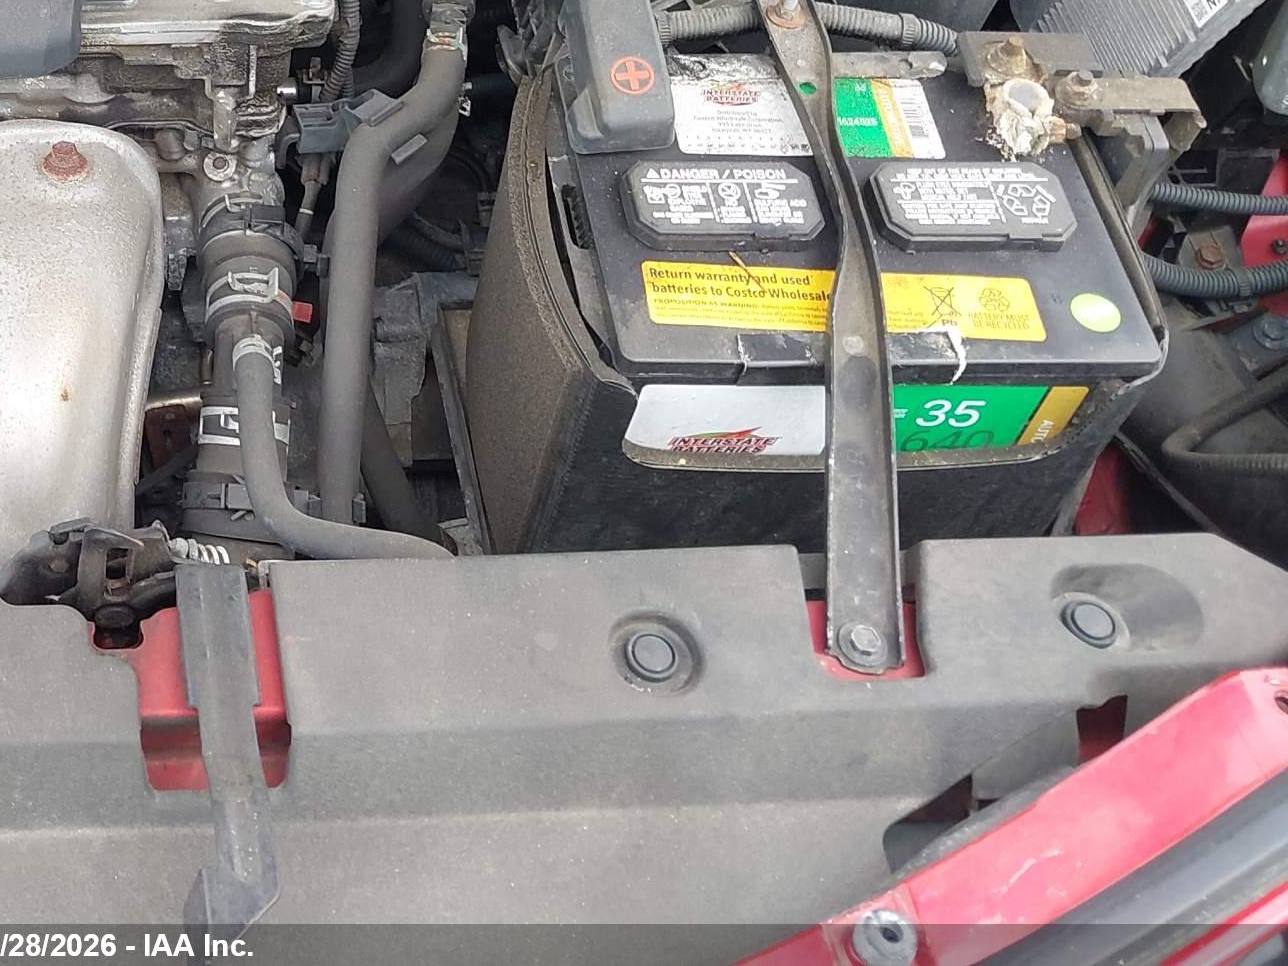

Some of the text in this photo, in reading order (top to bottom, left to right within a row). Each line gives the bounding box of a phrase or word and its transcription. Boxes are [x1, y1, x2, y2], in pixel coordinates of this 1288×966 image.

[660, 168, 719, 179] DANGER
[732, 168, 786, 179] POISON
[649, 267, 811, 286] Return warranty and used
[652, 281, 708, 295] batteries
[711, 285, 722, 296] to
[726, 286, 766, 299] Costco
[941, 319, 958, 327] Pb
[916, 399, 987, 427] 35
[669, 437, 779, 447] INTERSTATE
[671, 445, 764, 454] BATTERIES
